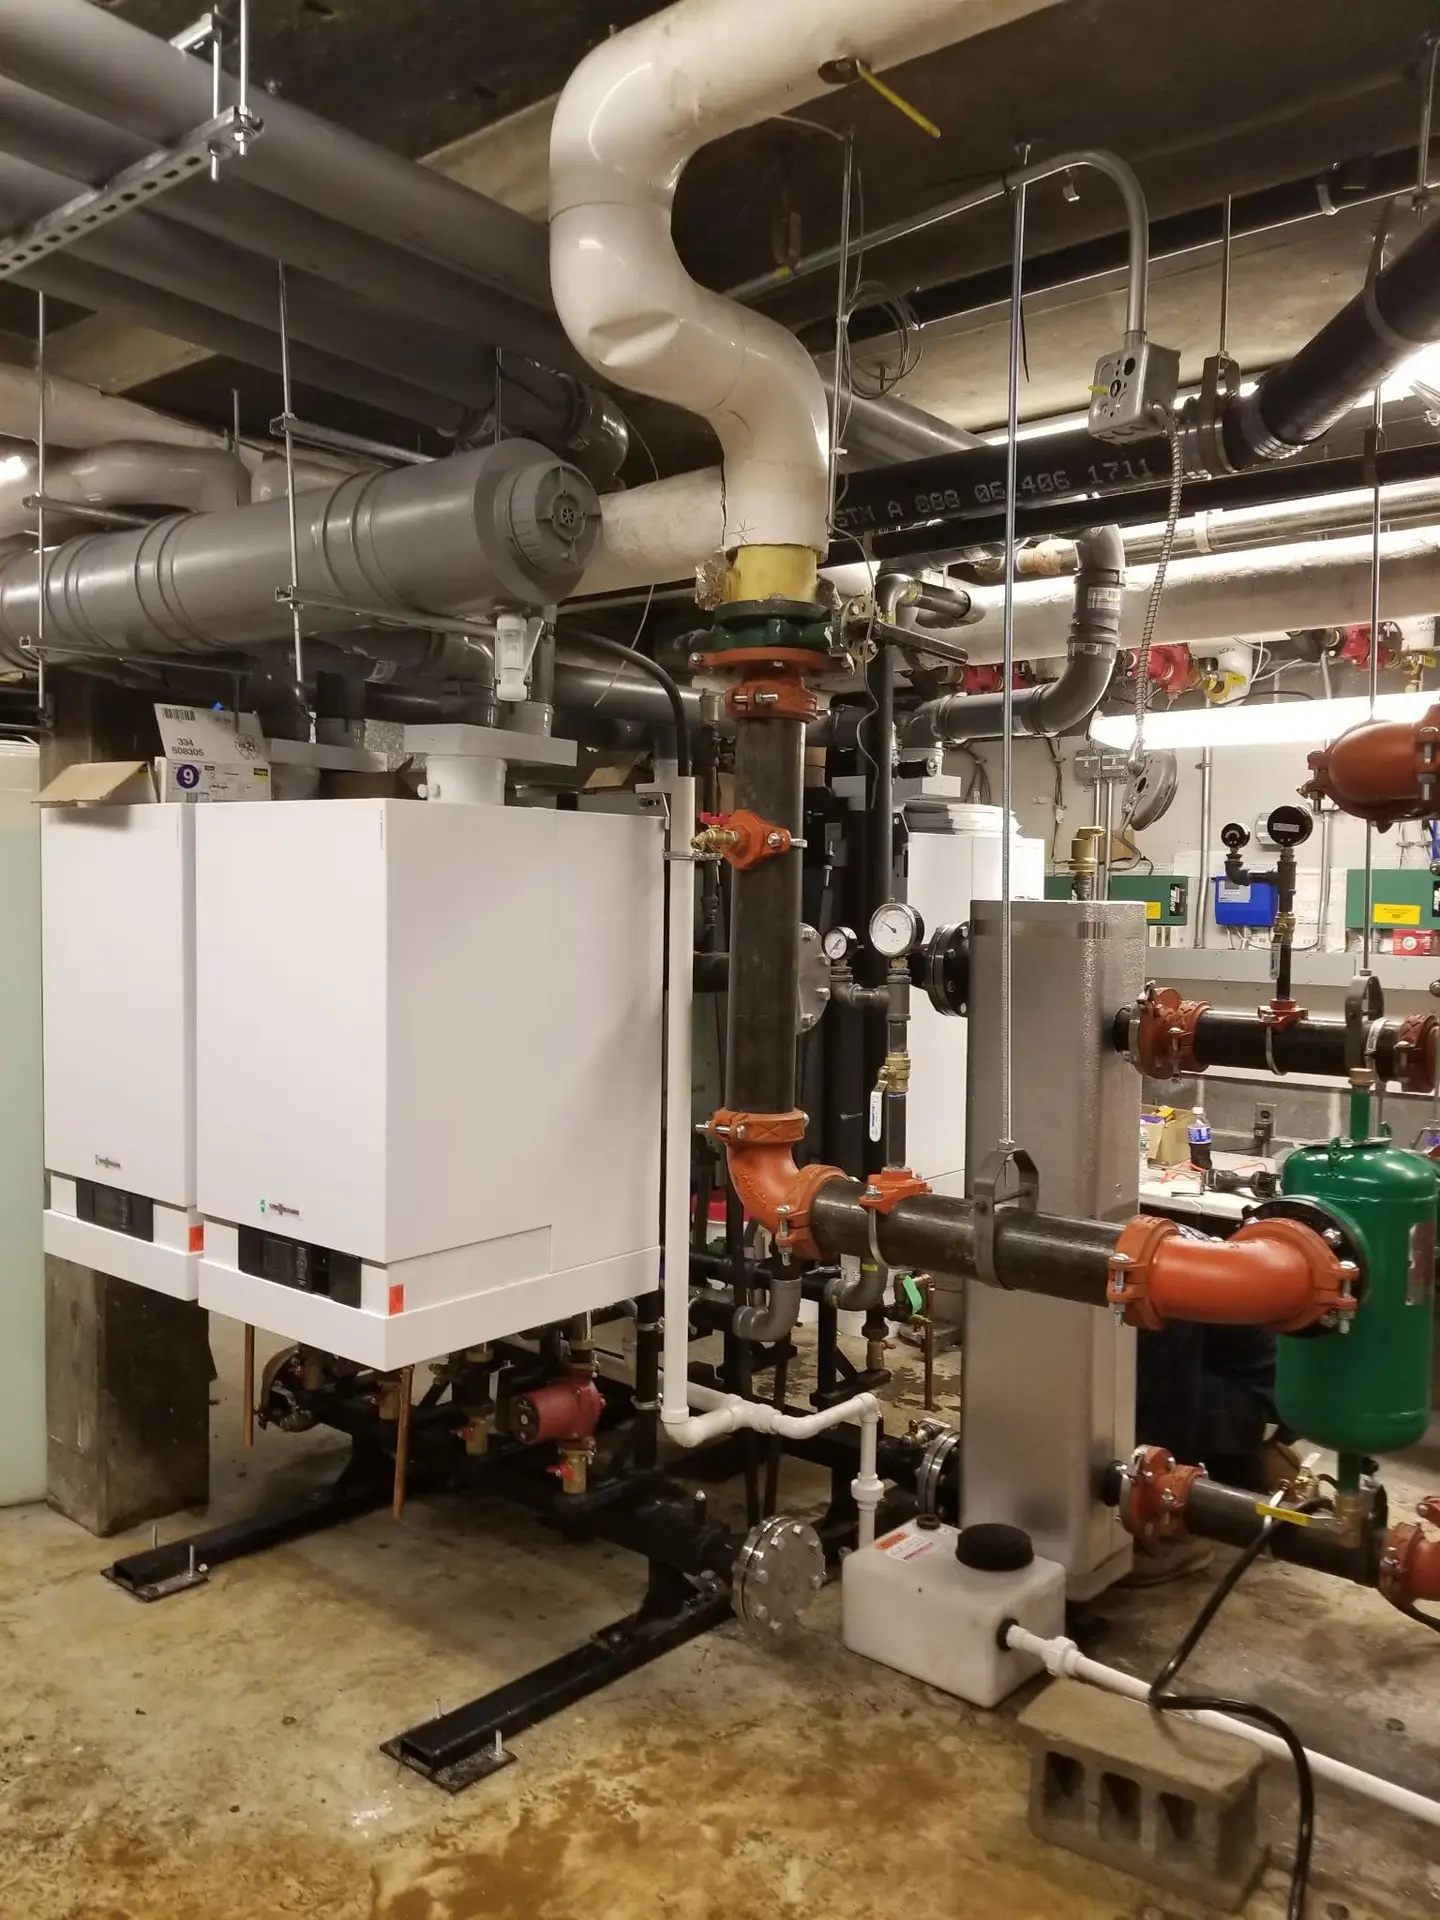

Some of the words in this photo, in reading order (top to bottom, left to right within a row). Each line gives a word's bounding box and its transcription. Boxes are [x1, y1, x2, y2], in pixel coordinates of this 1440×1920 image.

[887, 500, 903, 518] A
[1087, 457, 1153, 485] 1711
[177, 737, 194, 746] 334
